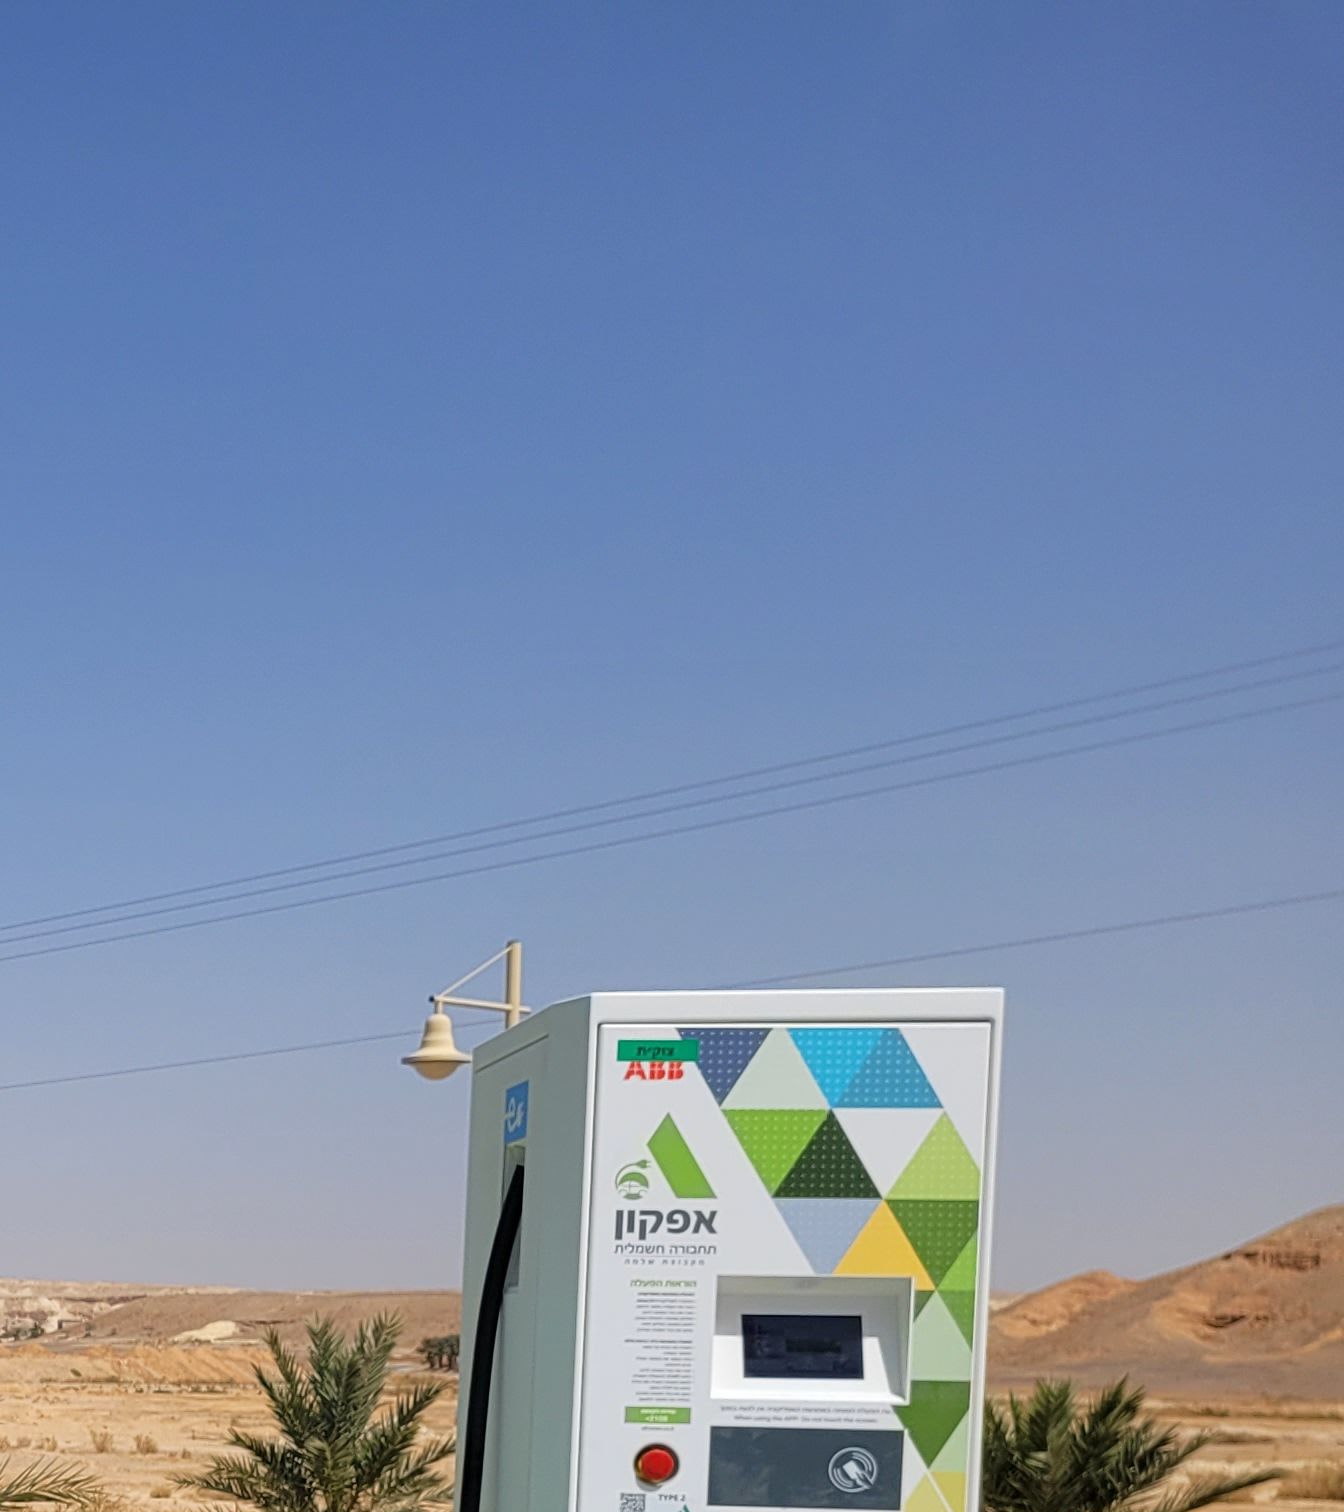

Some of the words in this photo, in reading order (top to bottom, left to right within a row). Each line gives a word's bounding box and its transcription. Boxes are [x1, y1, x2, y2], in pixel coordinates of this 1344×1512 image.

[623, 1060, 685, 1081] ABB
[615, 1209, 718, 1240] אפקון
[614, 1243, 665, 1254] חשמלית
[669, 1245, 717, 1254] תחבורה
